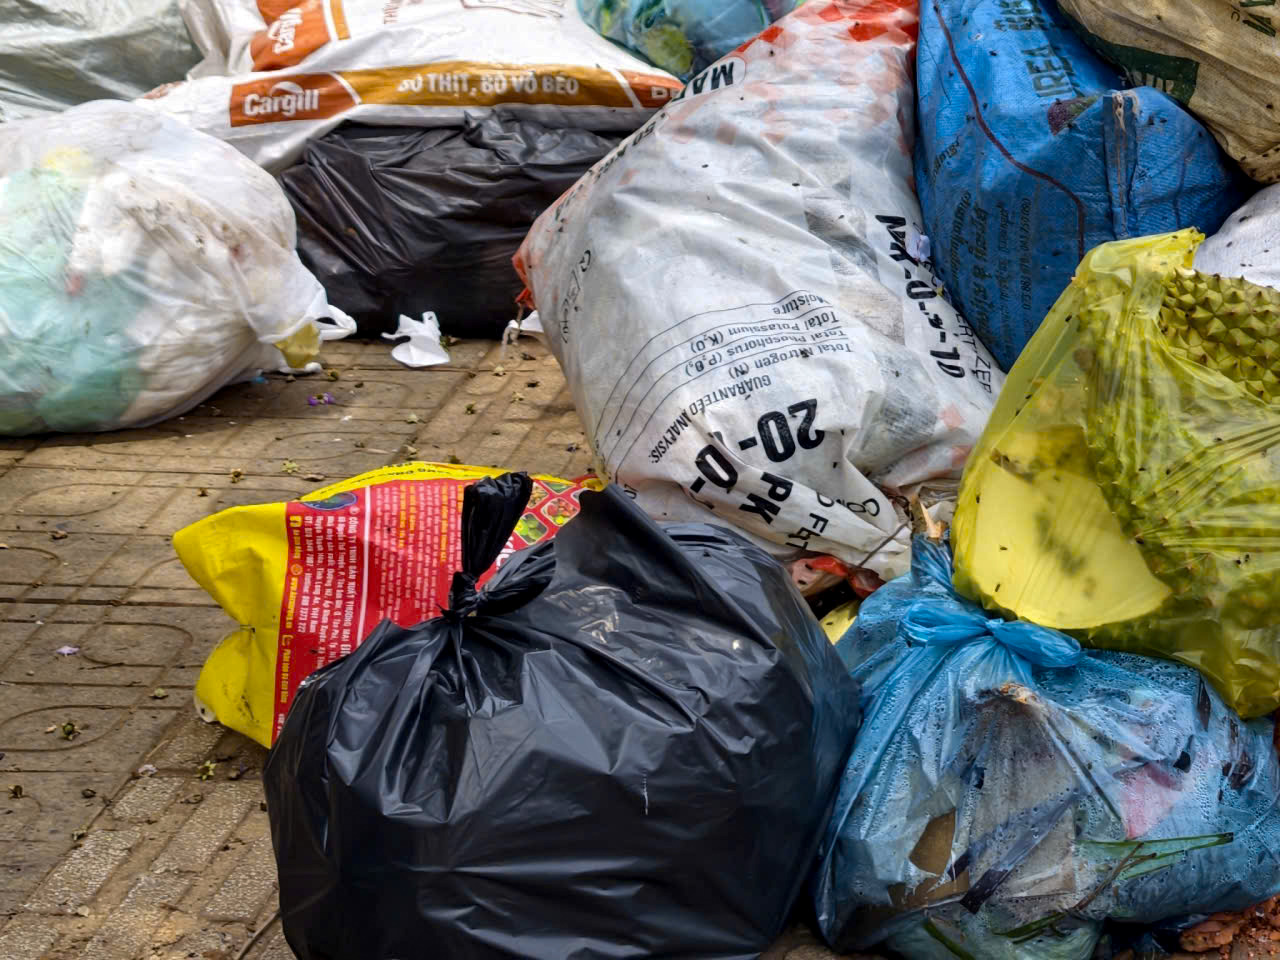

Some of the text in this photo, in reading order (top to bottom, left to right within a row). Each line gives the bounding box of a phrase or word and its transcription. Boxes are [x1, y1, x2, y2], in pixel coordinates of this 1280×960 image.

[242, 85, 320, 118] Cargill
[773, 294, 830, 315] Moisture
[804, 311, 839, 331] Total
[812, 329, 847, 339] Total
[818, 343, 853, 355] Total
[728, 361, 750, 379] (N)
[689, 374, 772, 416] GUARANTEED
